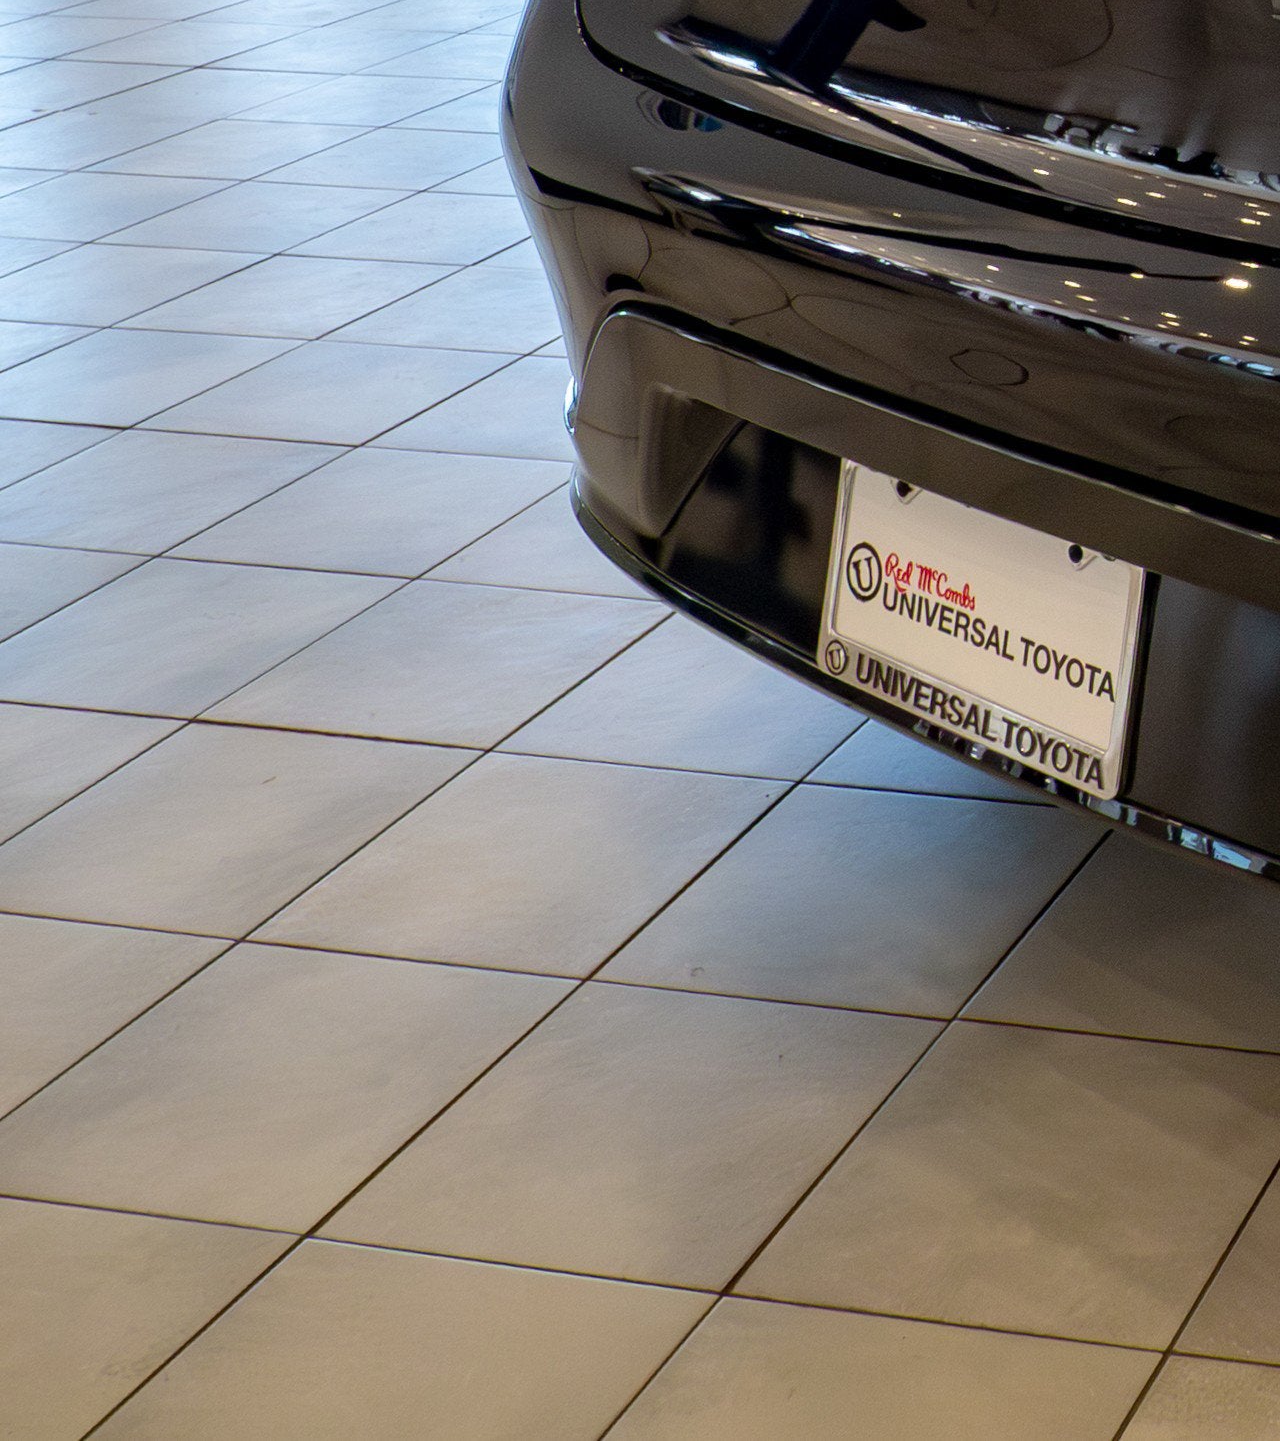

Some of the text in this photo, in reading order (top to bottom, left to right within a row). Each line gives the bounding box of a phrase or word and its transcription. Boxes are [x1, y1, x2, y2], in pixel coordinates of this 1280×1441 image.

[885, 552, 976, 611] Red McCombs
[881, 582, 1117, 703] UNIVERSAL TOYOTA
[855, 652, 1106, 791] UNIVERSAL TOYOTA
